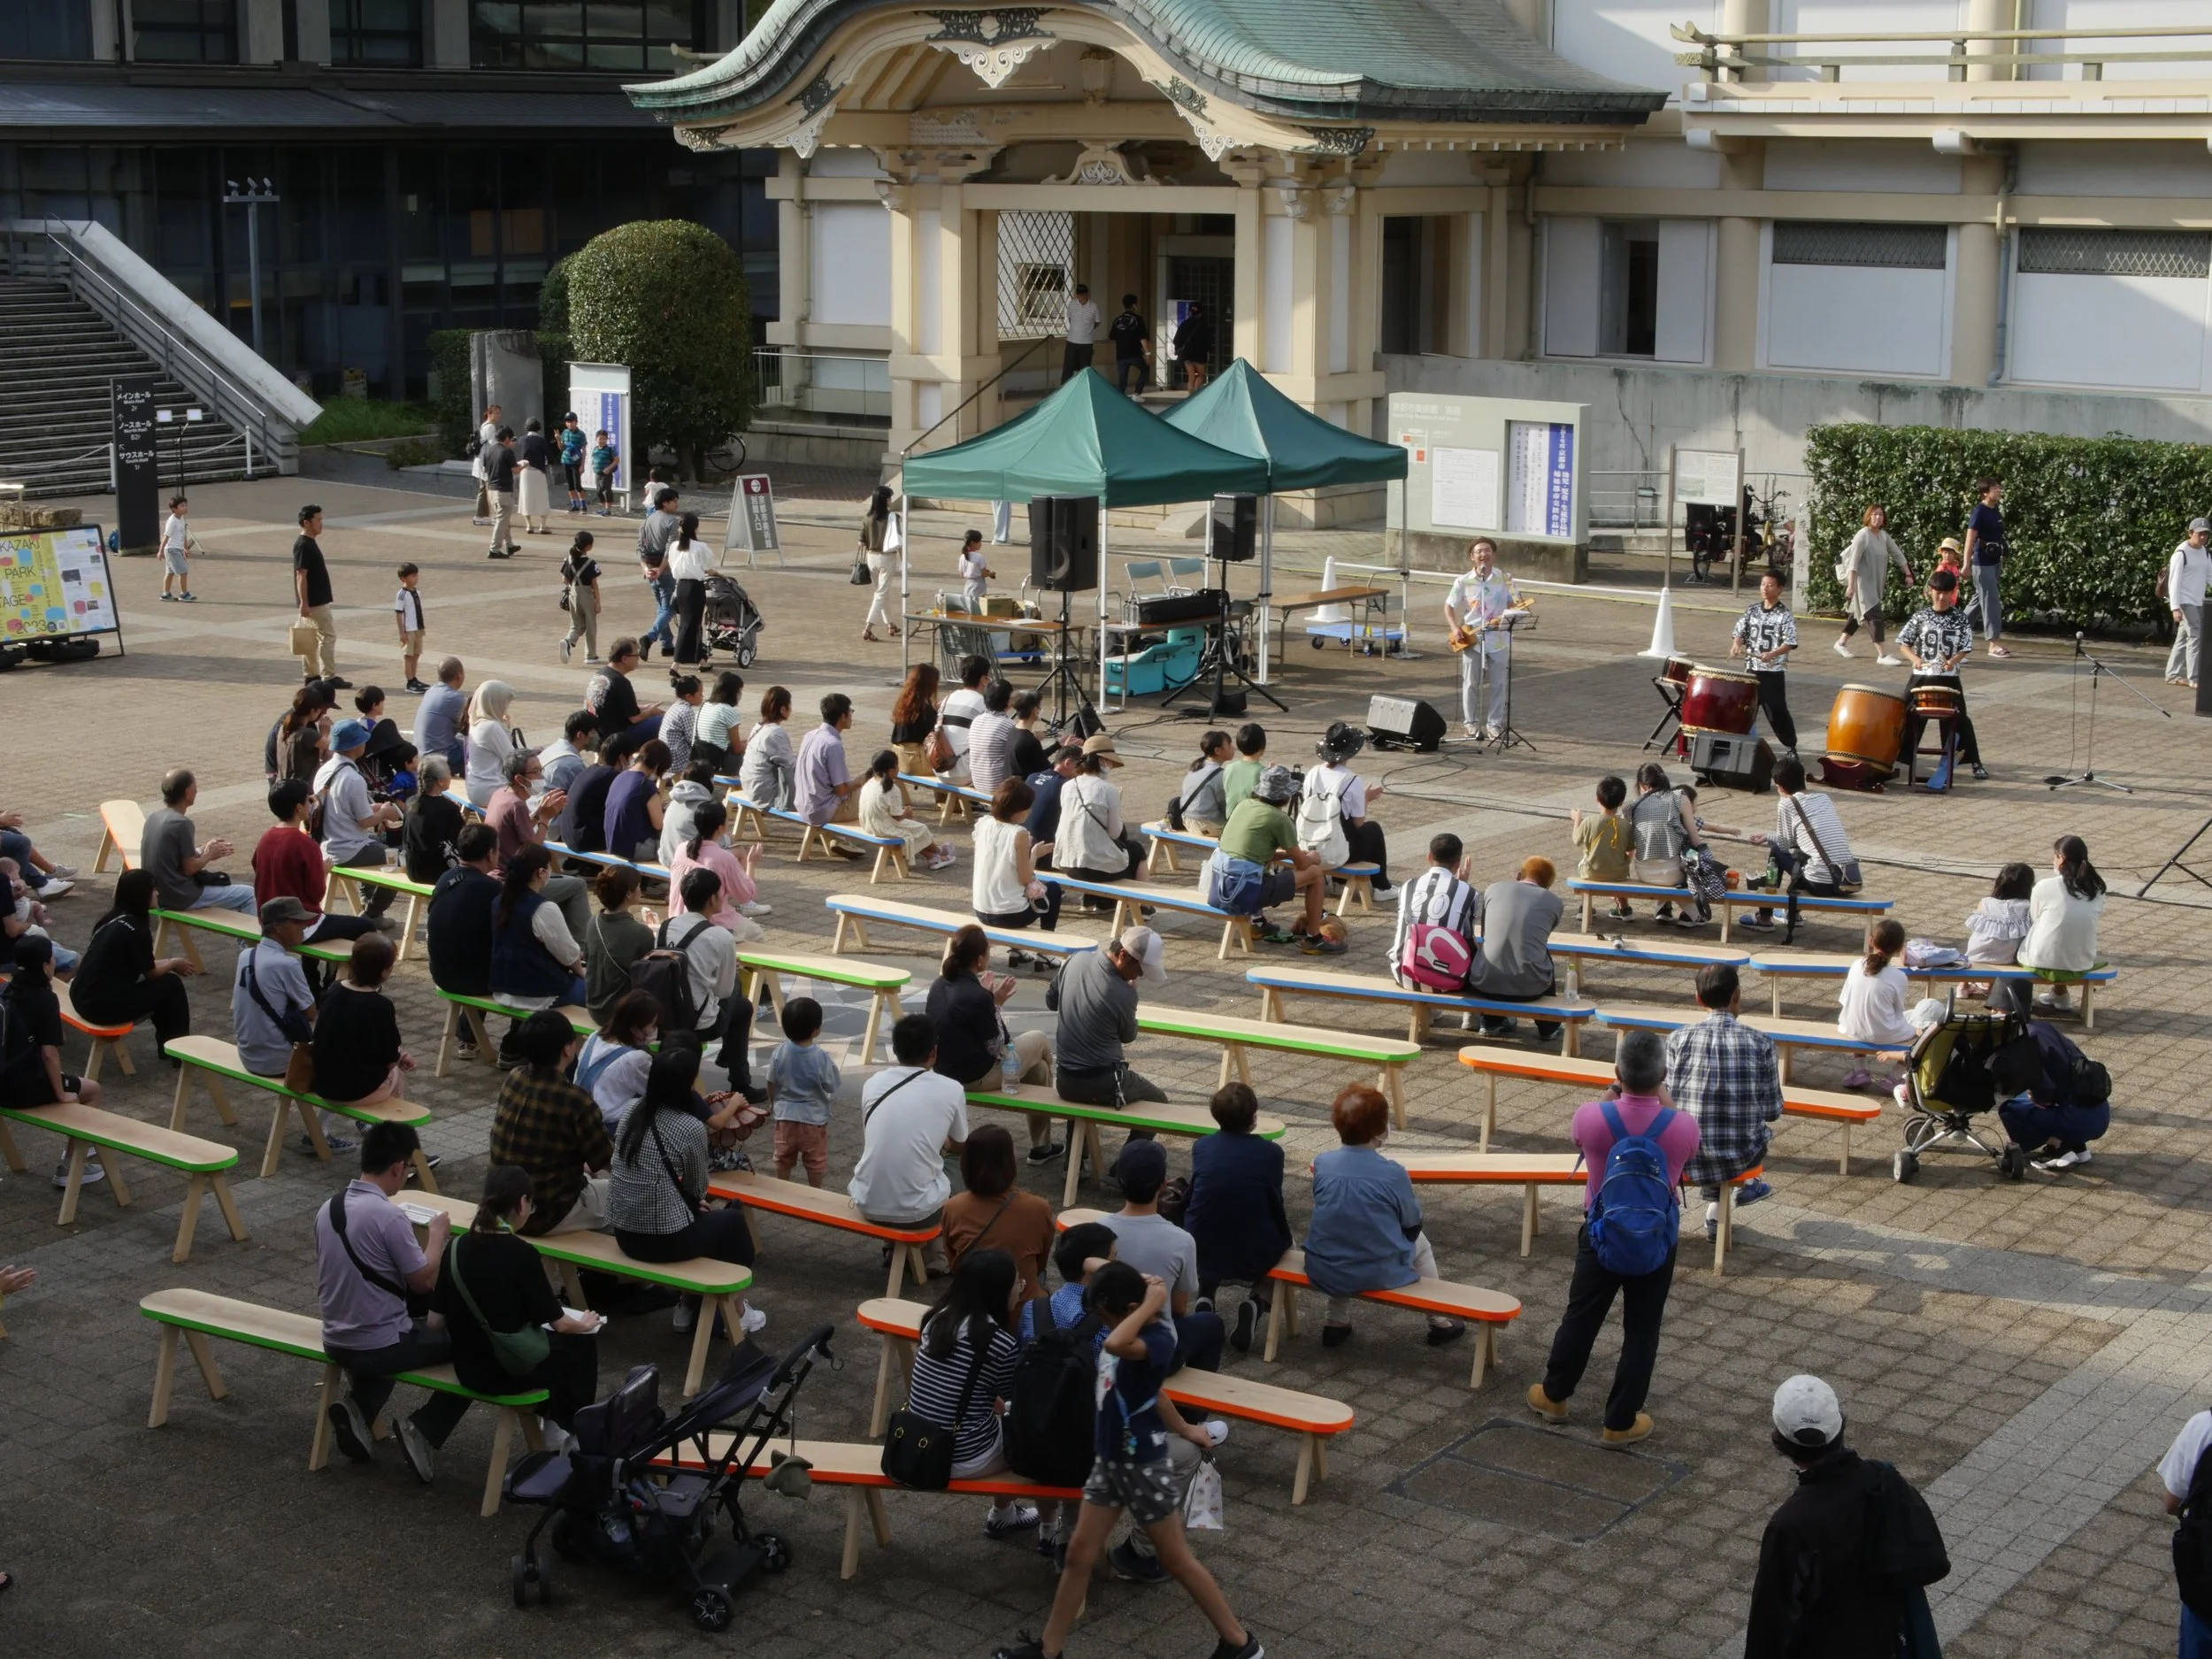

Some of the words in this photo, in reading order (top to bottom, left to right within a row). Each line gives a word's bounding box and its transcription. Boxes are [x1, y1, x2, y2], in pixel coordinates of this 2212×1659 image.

[117, 391, 151, 400] メインホール
[119, 420, 152, 429] ノースホール
[119, 450, 154, 459] サウスホール
[750, 495, 762, 531] 別館入口
[758, 495, 773, 548] 京都市美術館
[5, 566, 36, 580] PARK
[15, 620, 47, 634] 2023
[1924, 629, 1957, 660] 95
[1410, 891, 1450, 920] 20
